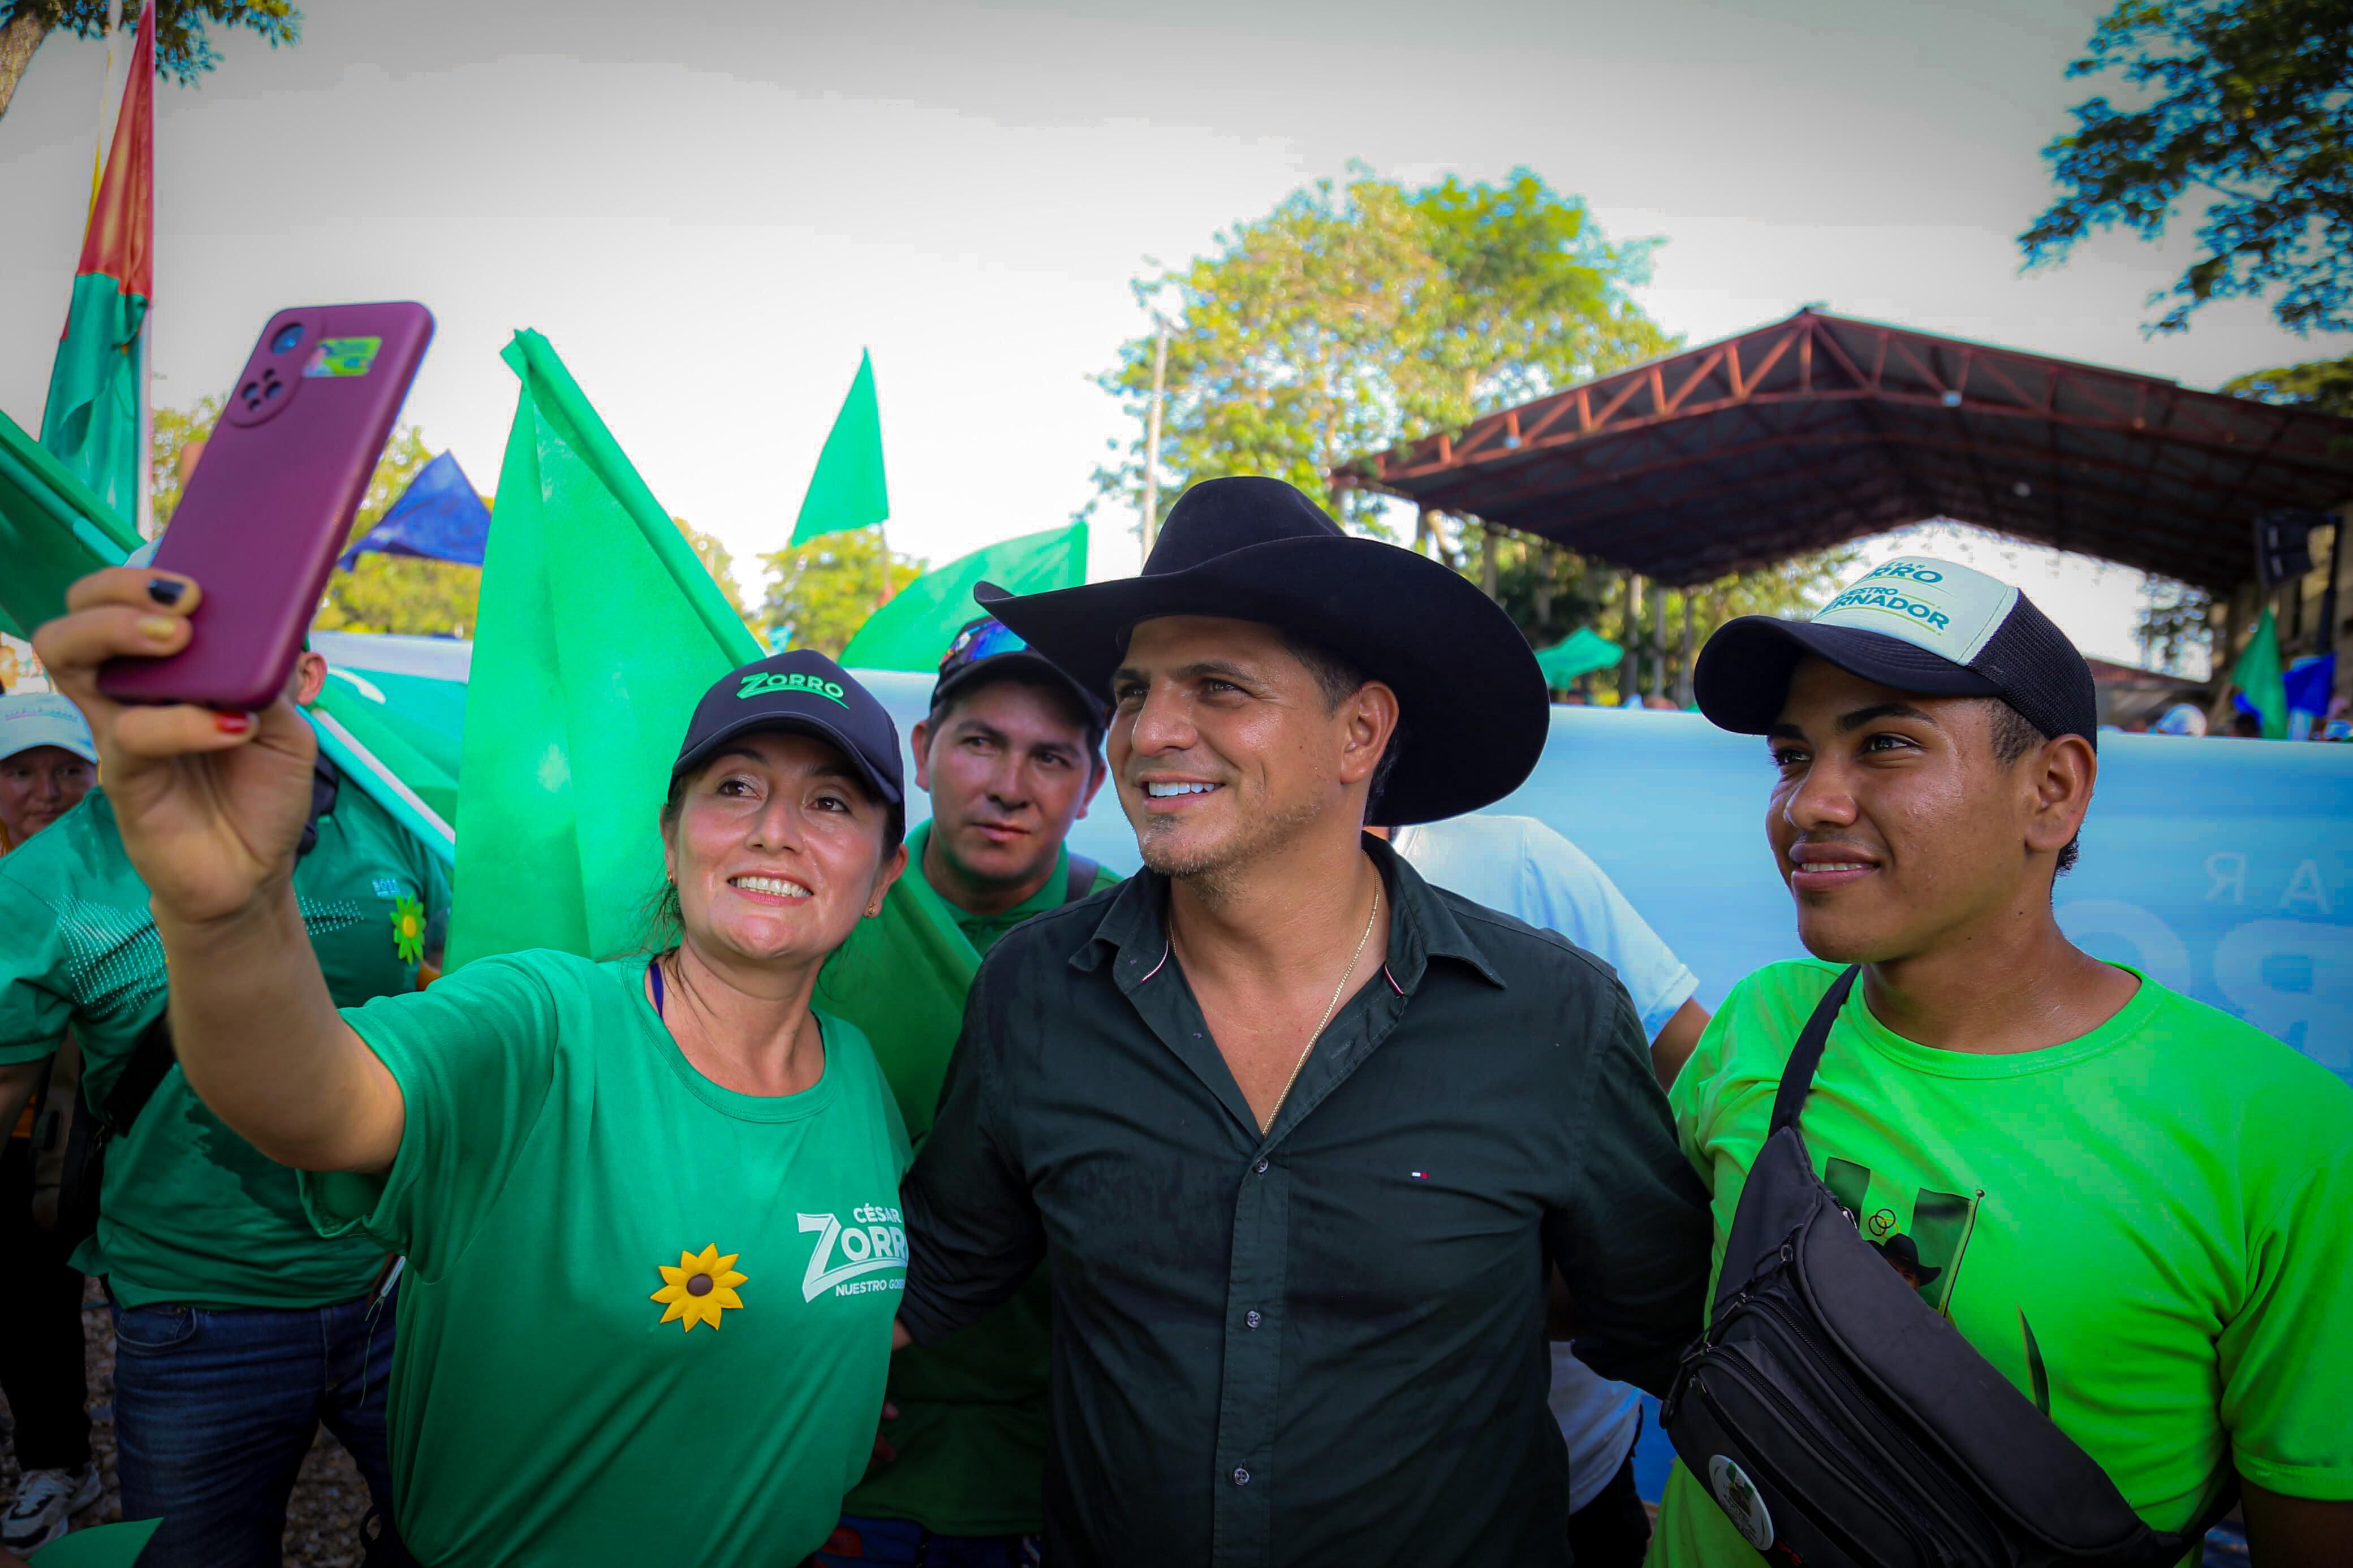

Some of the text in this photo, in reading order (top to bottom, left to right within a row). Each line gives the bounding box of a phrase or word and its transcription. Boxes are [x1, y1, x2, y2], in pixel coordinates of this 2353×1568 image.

[736, 671, 850, 710] ZORRO
[853, 1203, 902, 1223] CÉSAR
[796, 1212, 909, 1303] ZORR
[835, 1279, 886, 1297] NUESTRO
